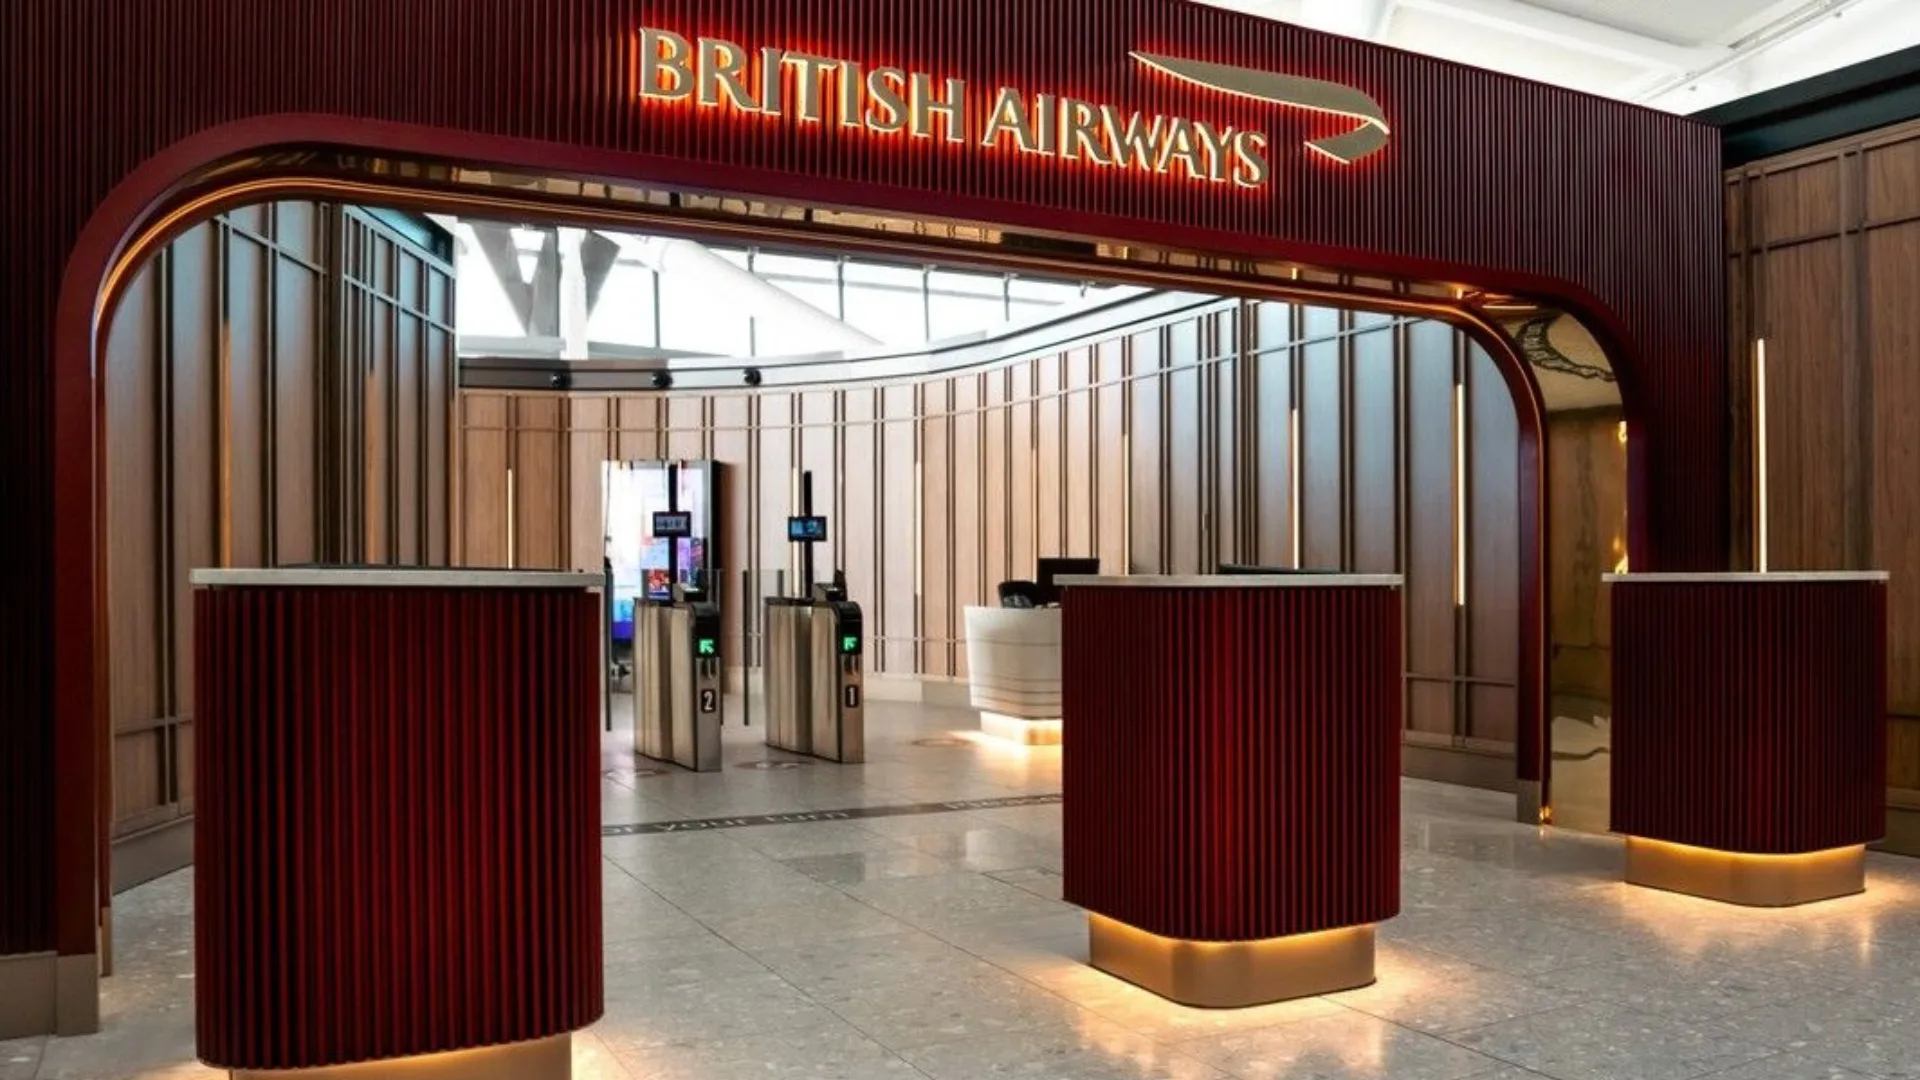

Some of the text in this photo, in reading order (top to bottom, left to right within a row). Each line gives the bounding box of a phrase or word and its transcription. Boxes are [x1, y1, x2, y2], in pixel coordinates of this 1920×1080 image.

[639, 26, 1270, 188] BRITISH AIRWAYS
[703, 690, 713, 711] 2
[848, 687, 856, 706] 1
